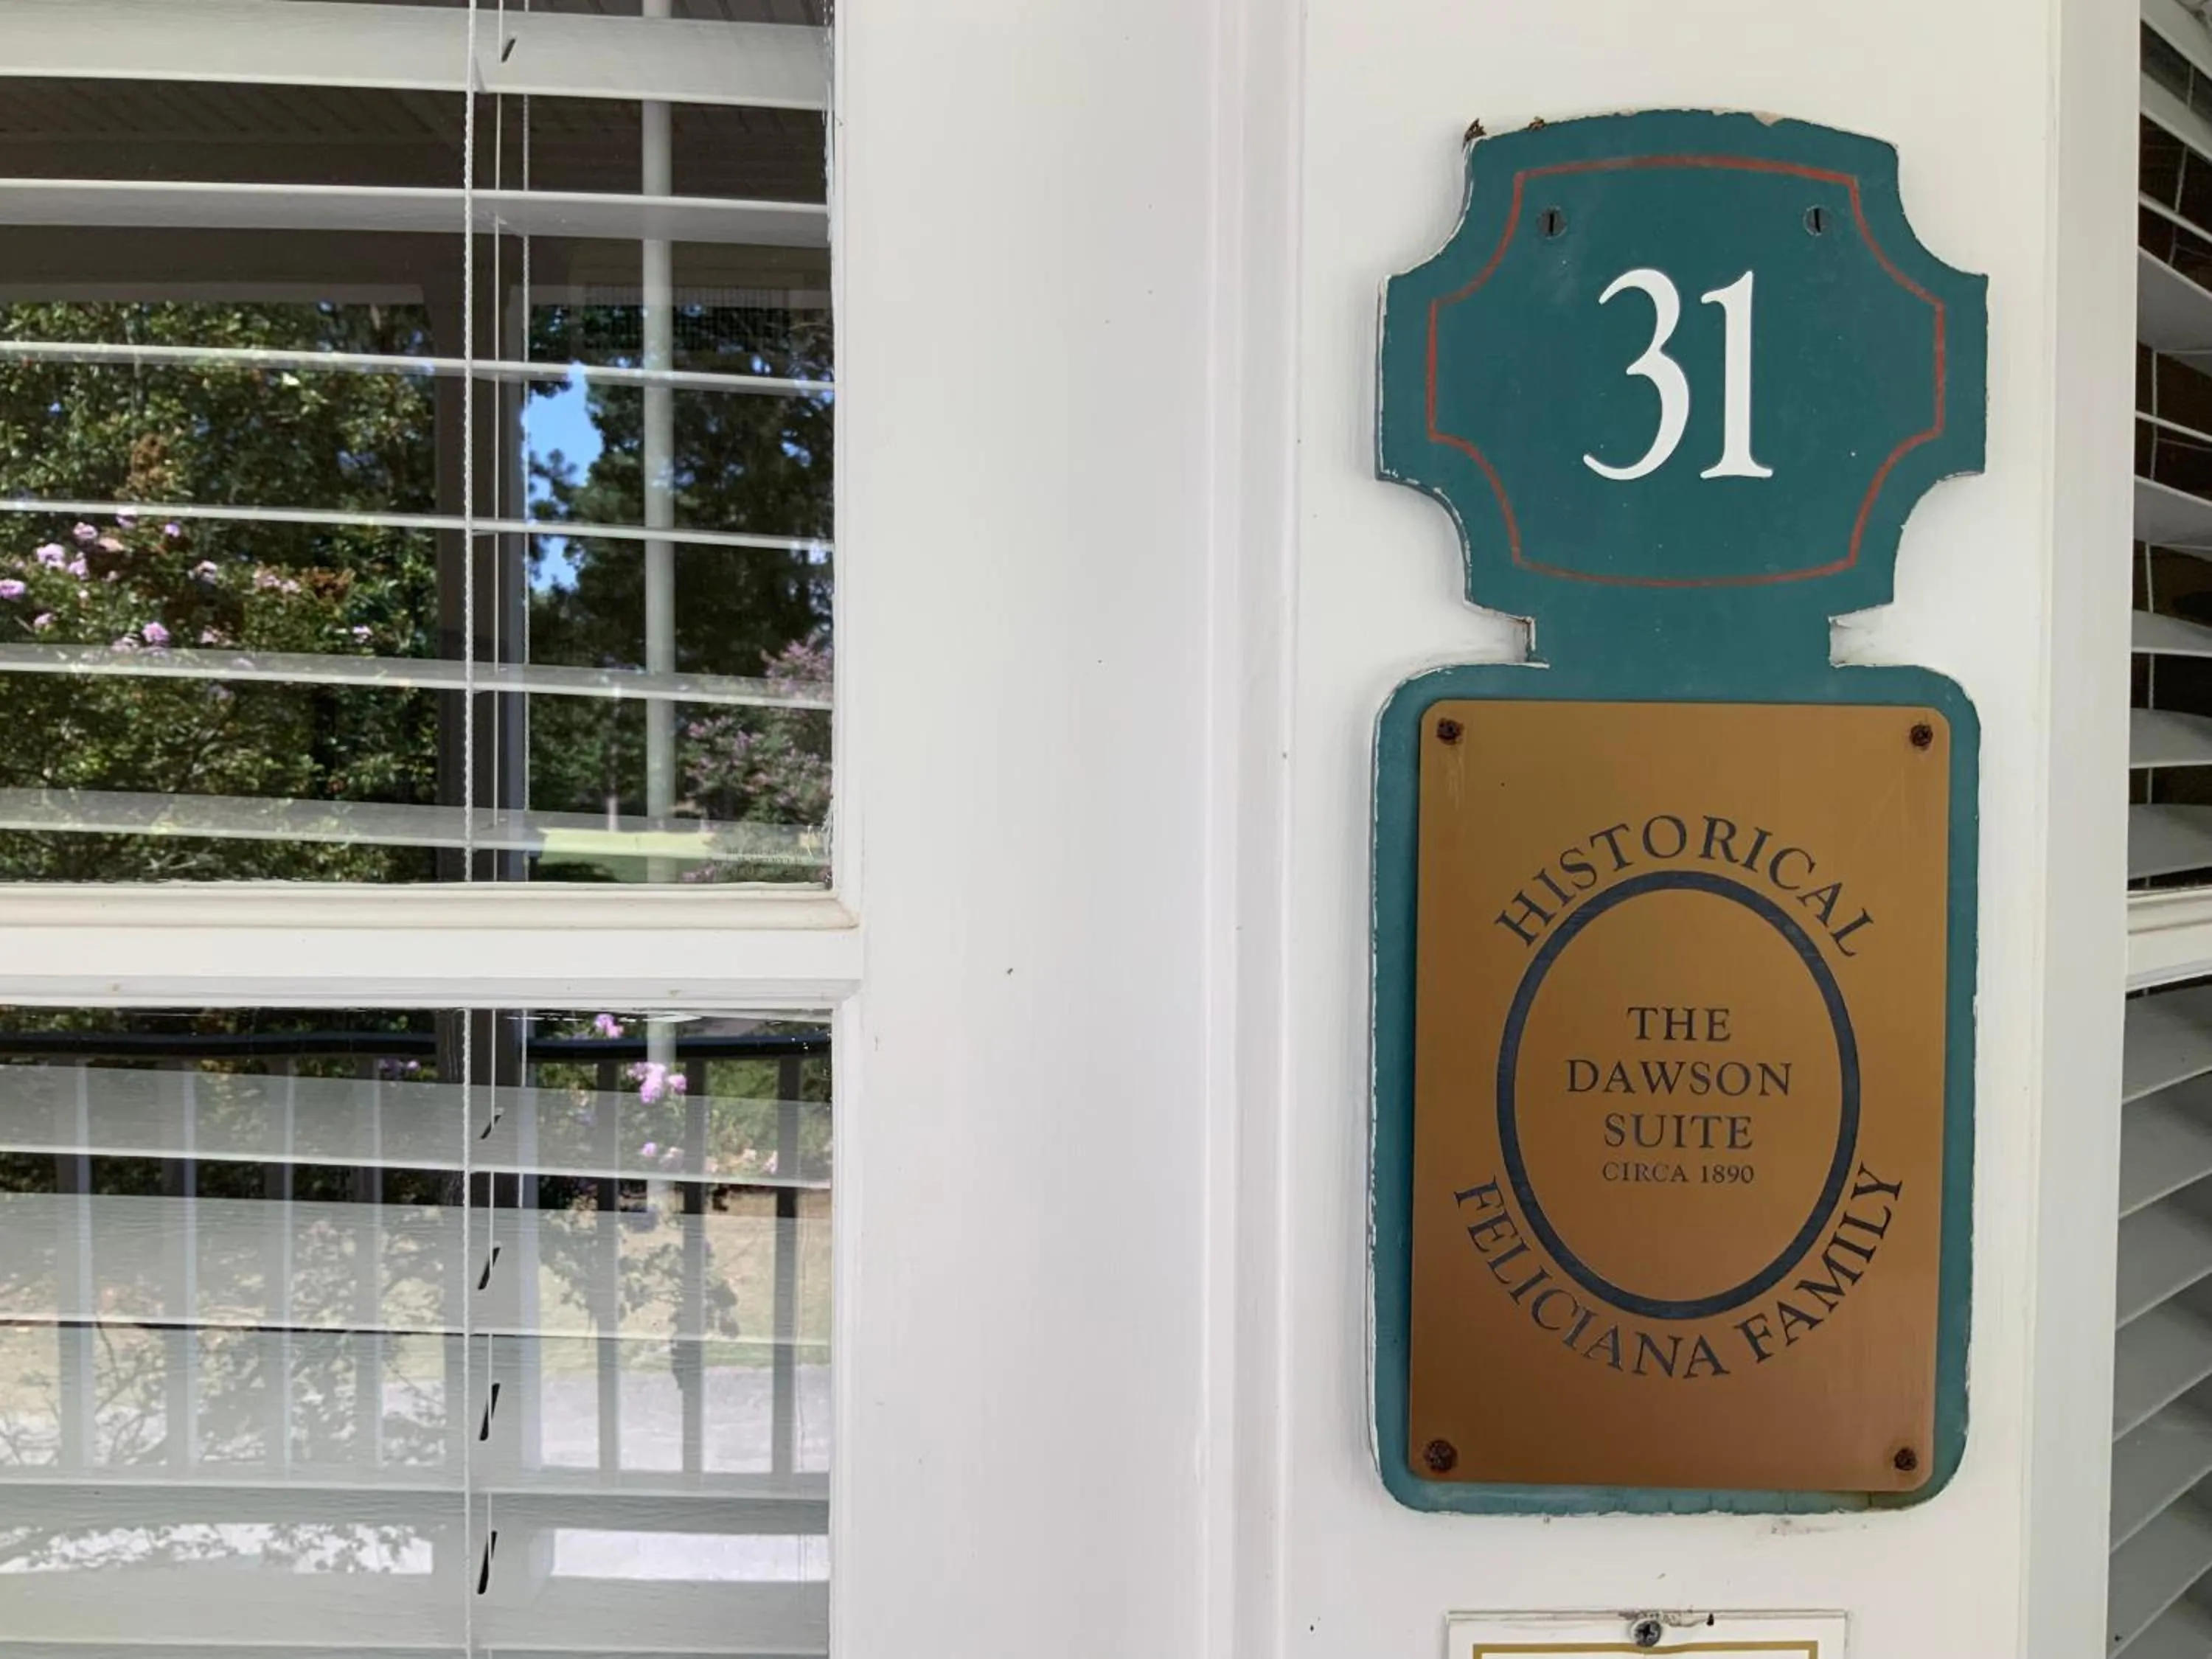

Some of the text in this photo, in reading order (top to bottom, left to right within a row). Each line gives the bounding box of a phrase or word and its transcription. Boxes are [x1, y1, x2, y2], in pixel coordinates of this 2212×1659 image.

[1583, 268, 1773, 480] 31
[1494, 814, 1874, 959] HISTORICAL
[1627, 1006, 1731, 1043] THE
[1565, 1059, 1792, 1097] DAWSON
[1603, 1112, 1754, 1150] SUITE
[1601, 1161, 1755, 1184] CIRCA 1890
[1453, 1160, 1904, 1380] FELICIANA FAMILY
